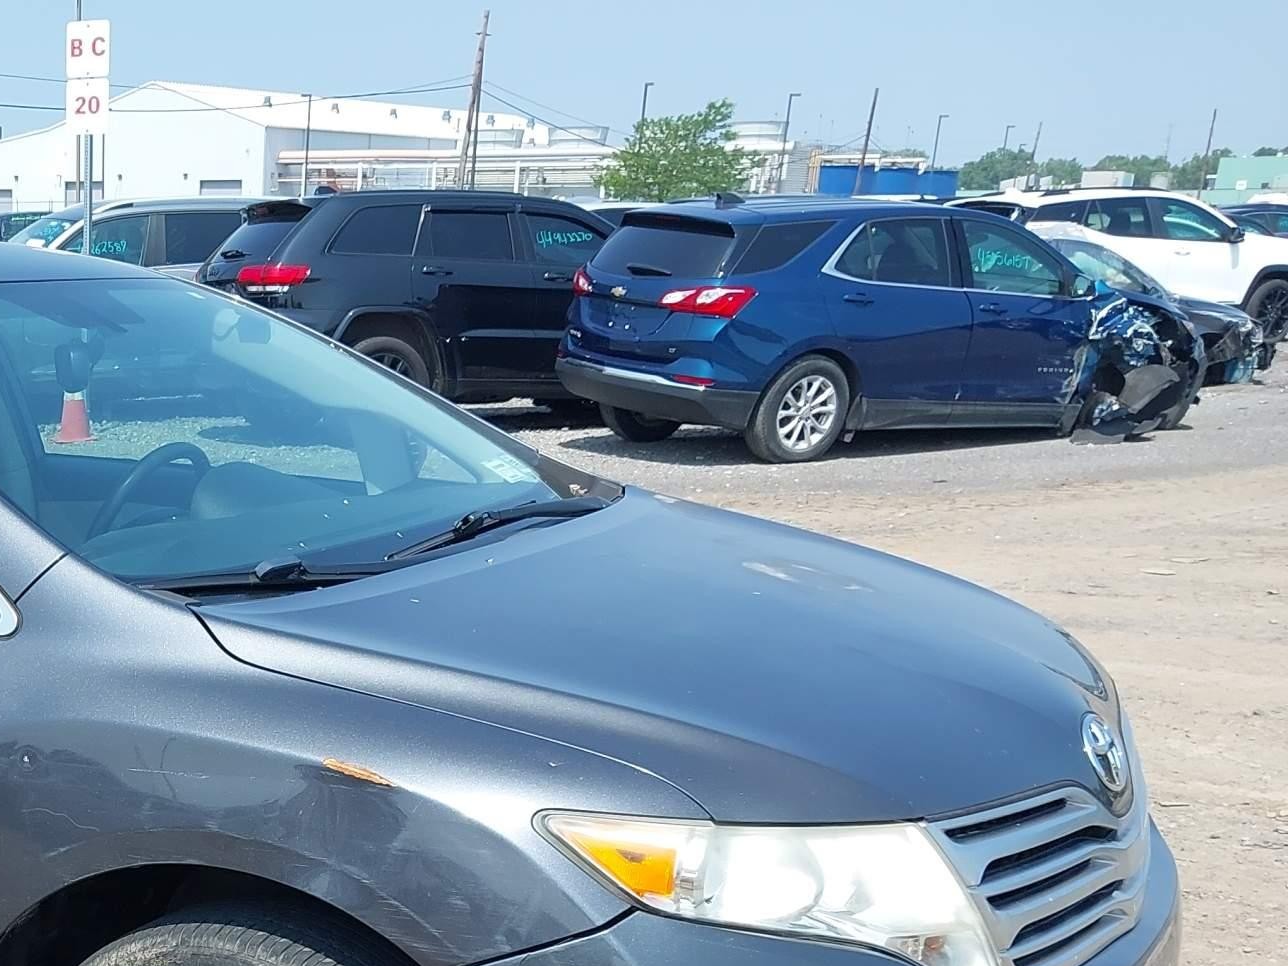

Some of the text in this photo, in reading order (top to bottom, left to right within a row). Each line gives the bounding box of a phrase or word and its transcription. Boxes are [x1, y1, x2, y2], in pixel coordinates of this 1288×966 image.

[70, 36, 106, 57] B C
[74, 96, 100, 115] 20
